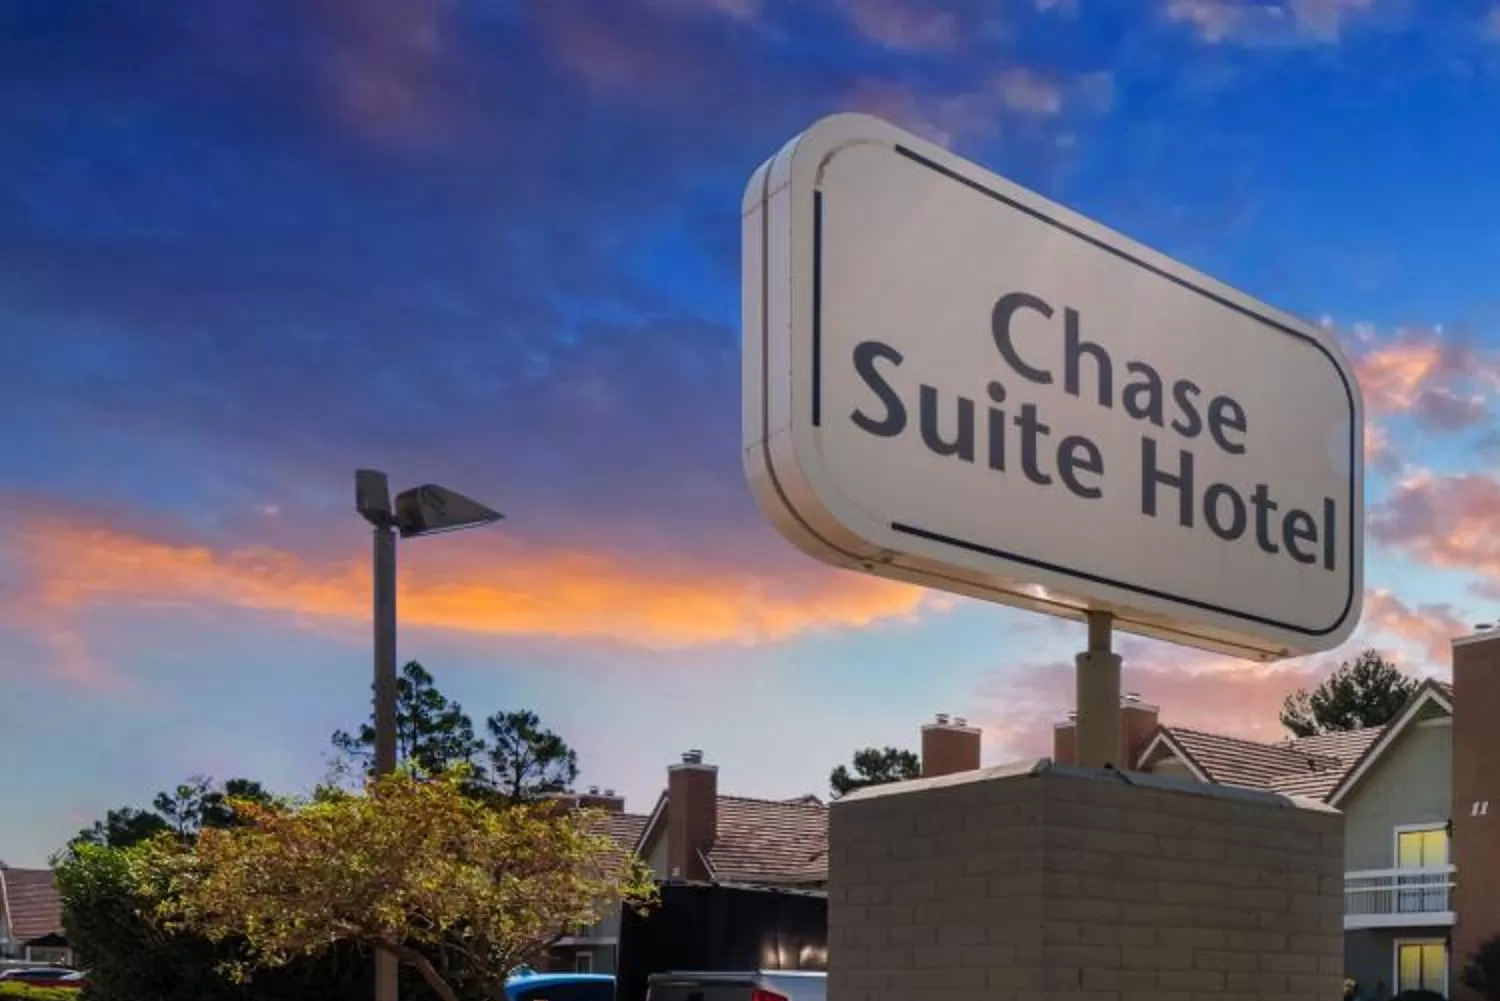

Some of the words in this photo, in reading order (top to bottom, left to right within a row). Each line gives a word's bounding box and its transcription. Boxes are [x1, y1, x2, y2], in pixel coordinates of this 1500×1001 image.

[849, 340, 1105, 500] Suite
[1140, 435, 1337, 573] Hotel
[991, 291, 1248, 456] Chase
